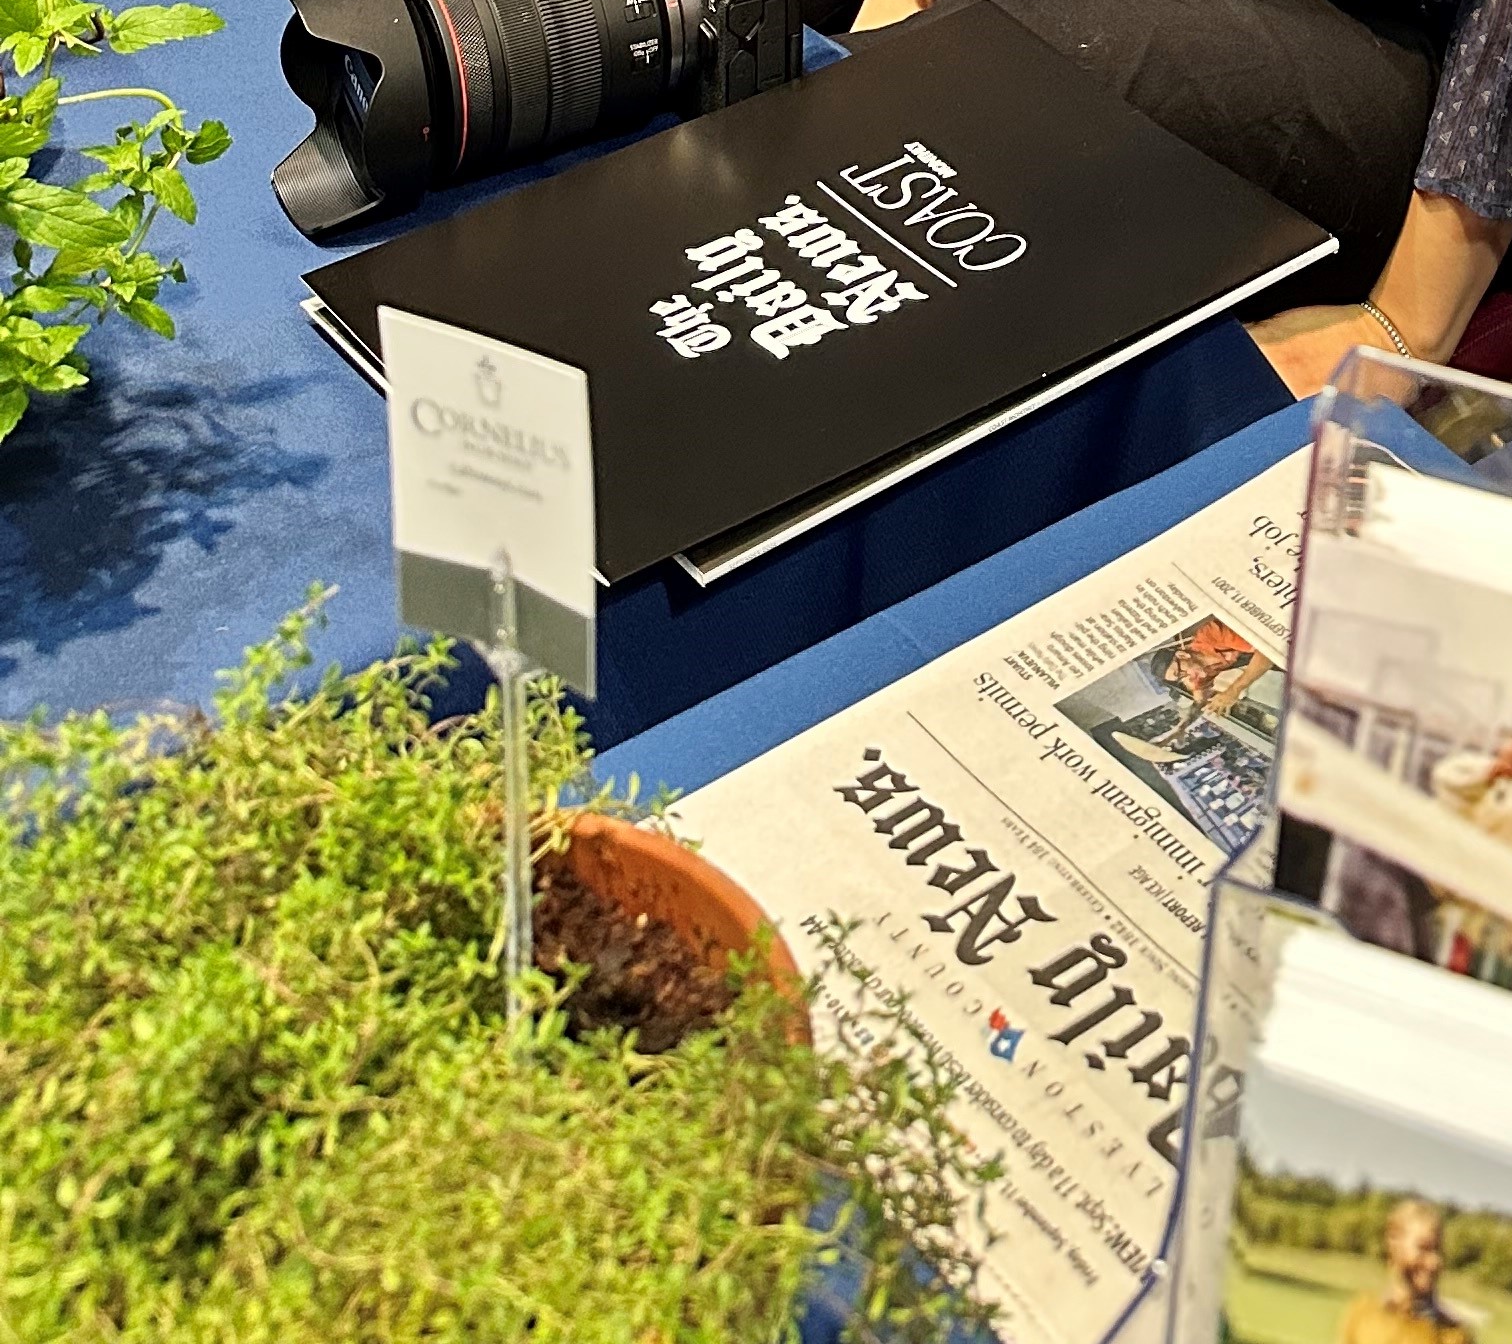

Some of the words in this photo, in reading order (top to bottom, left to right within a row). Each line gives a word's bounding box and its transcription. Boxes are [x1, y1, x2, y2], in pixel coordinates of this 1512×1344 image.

[839, 153, 1028, 272] COAST
[649, 293, 732, 359] The
[684, 228, 850, 360] Daily
[1248, 515, 1300, 551] job
[1210, 576, 1236, 595] 2001
[973, 672, 1059, 740] permits
[1039, 736, 1098, 783] work
[1090, 779, 1206, 881] immigrant
[1028, 933, 1193, 1169] aily
